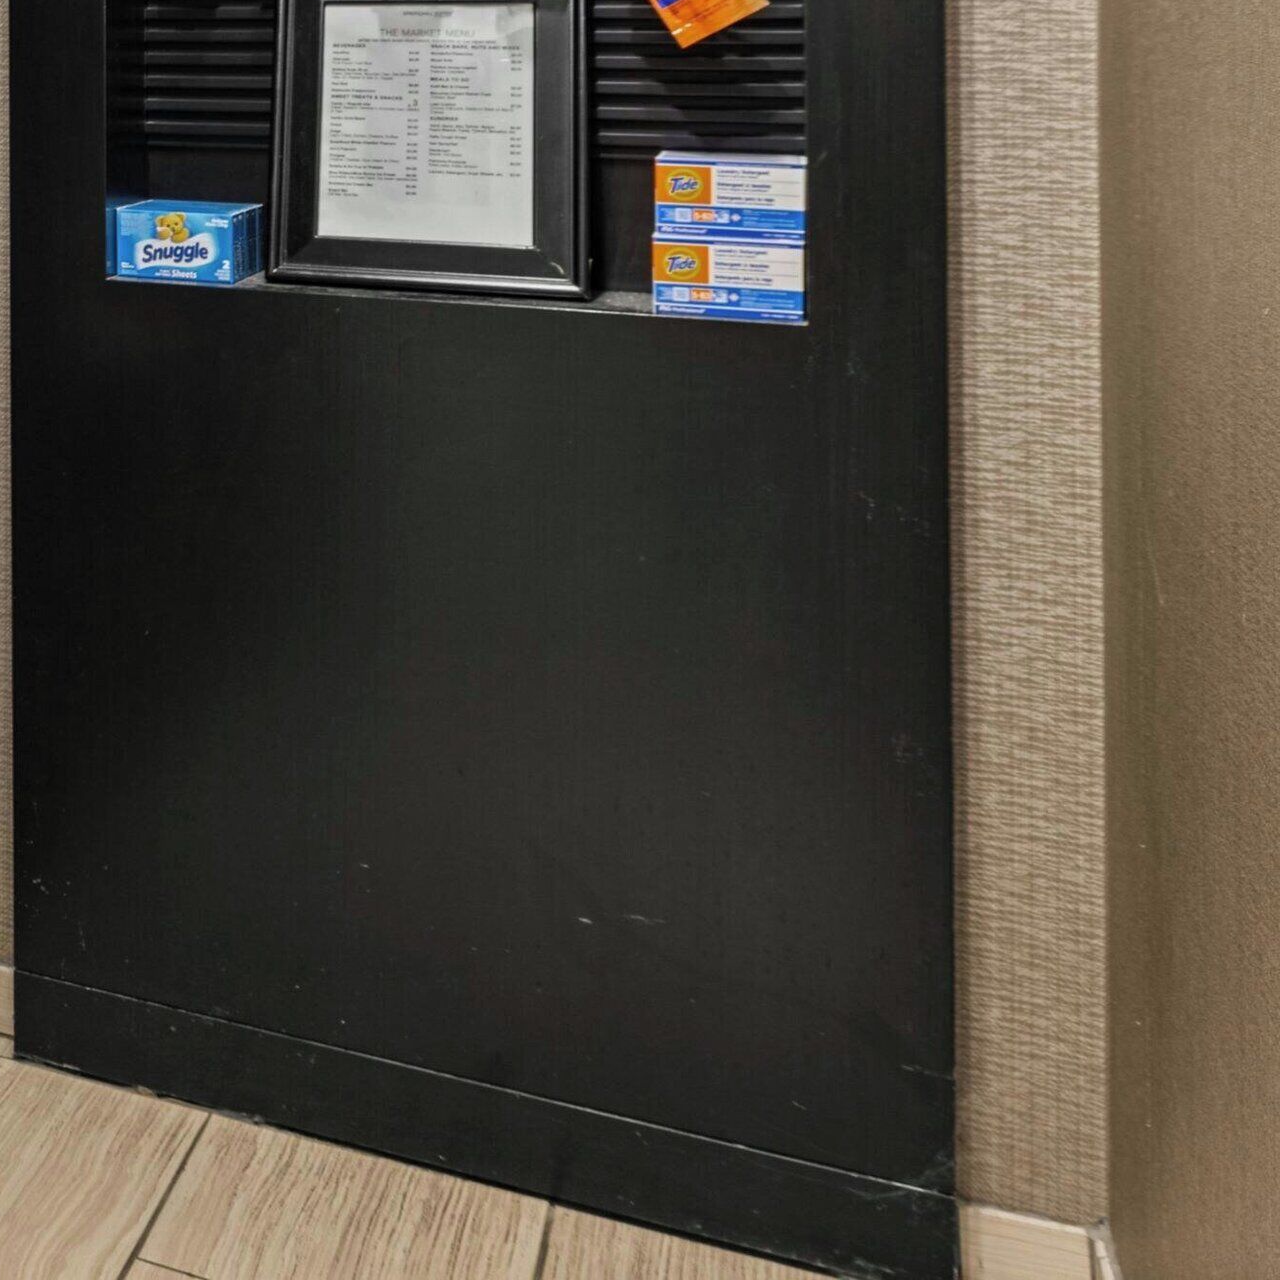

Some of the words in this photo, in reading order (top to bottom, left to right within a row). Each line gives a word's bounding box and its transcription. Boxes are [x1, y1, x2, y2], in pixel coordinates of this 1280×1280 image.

[380, 28, 398, 37] THE
[402, 28, 441, 38] MARKET
[670, 176, 699, 193] Tide
[142, 242, 209, 264] Snuggle
[222, 260, 231, 269] 2
[667, 256, 697, 273] Tide
[171, 270, 198, 279] Sheets
